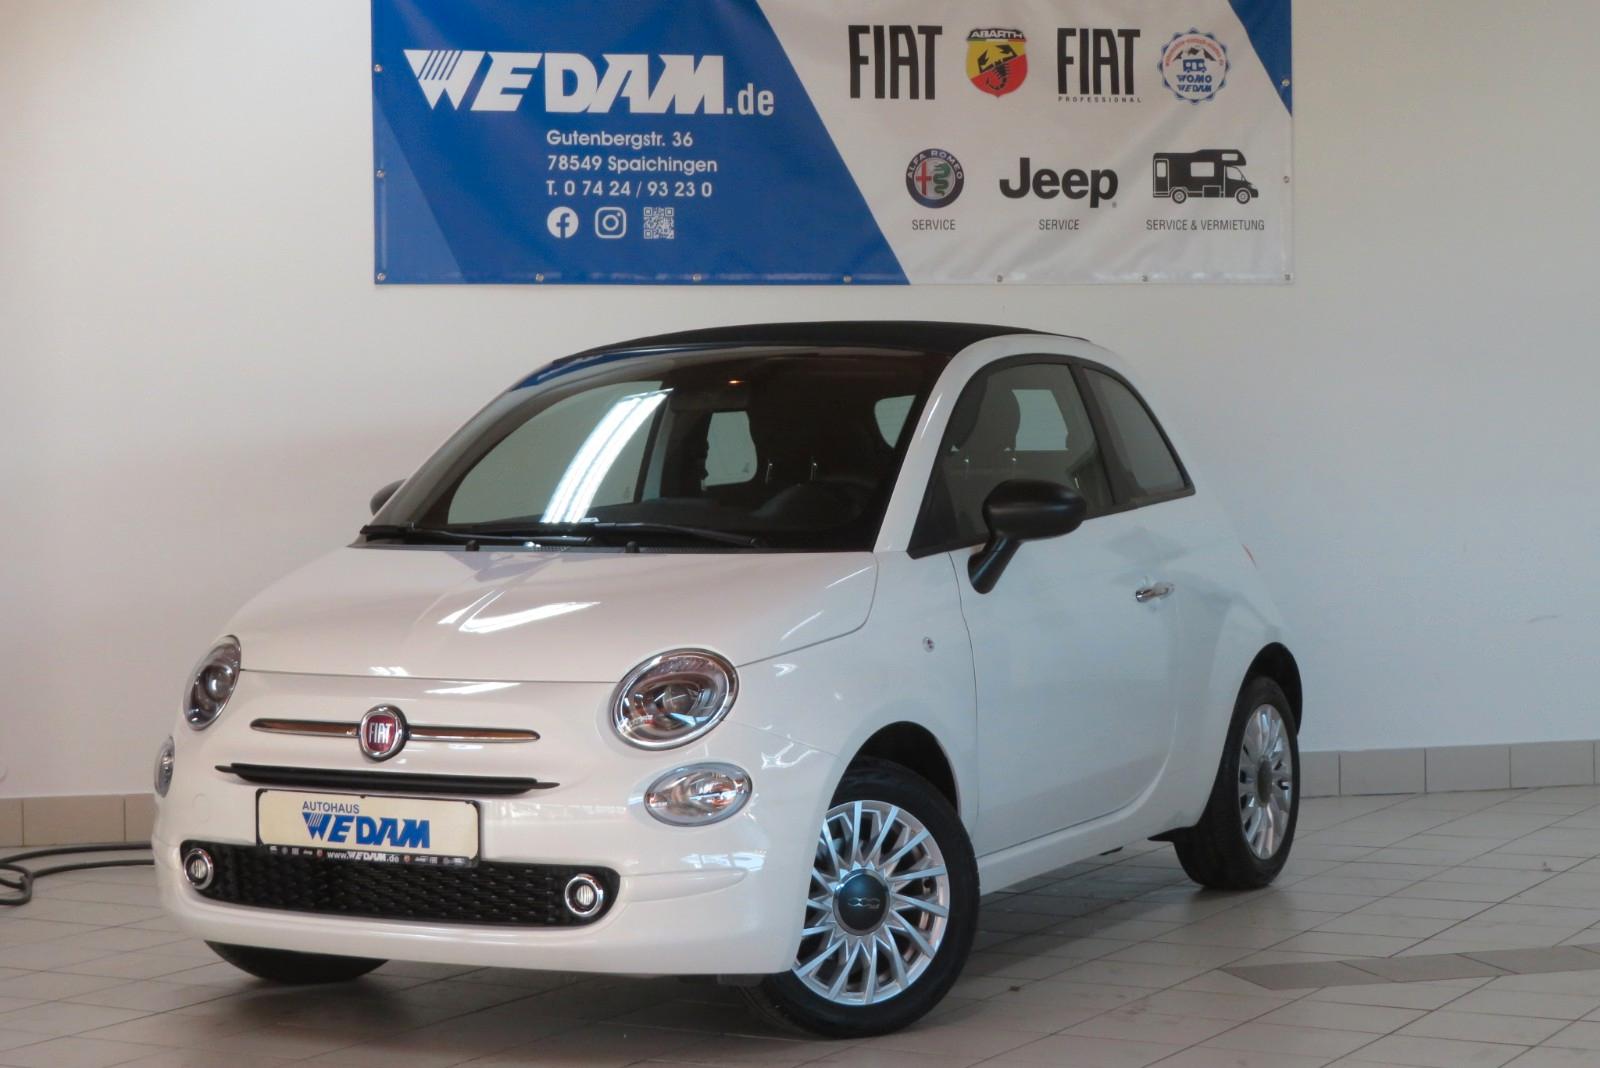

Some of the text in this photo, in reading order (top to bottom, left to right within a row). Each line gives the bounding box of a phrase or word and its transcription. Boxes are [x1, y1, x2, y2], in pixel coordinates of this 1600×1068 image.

[969, 29, 1026, 40] ABARTH
[849, 25, 943, 100] FIAT
[1057, 28, 1141, 95] FIAT
[546, 130, 694, 150] Gutenbergstr. 36
[548, 155, 718, 176] 78549 Spaichingen
[907, 149, 963, 180] ALFA ROMEO
[546, 180, 558, 196] T.
[564, 181, 576, 196] 0
[582, 180, 603, 196] 74
[609, 181, 631, 197] 24
[647, 182, 669, 197] 93
[674, 182, 696, 197] 23
[701, 182, 713, 198] 0
[999, 157, 1119, 208] Jeep
[911, 219, 956, 231] SERVICE
[1038, 219, 1080, 231] SERVICE
[1146, 219, 1265, 231] SERVICE & VERMIETUNG
[368, 722, 393, 745] FIAT
[302, 800, 360, 814] AUTOHAUS
[302, 812, 430, 848] WEDAM
